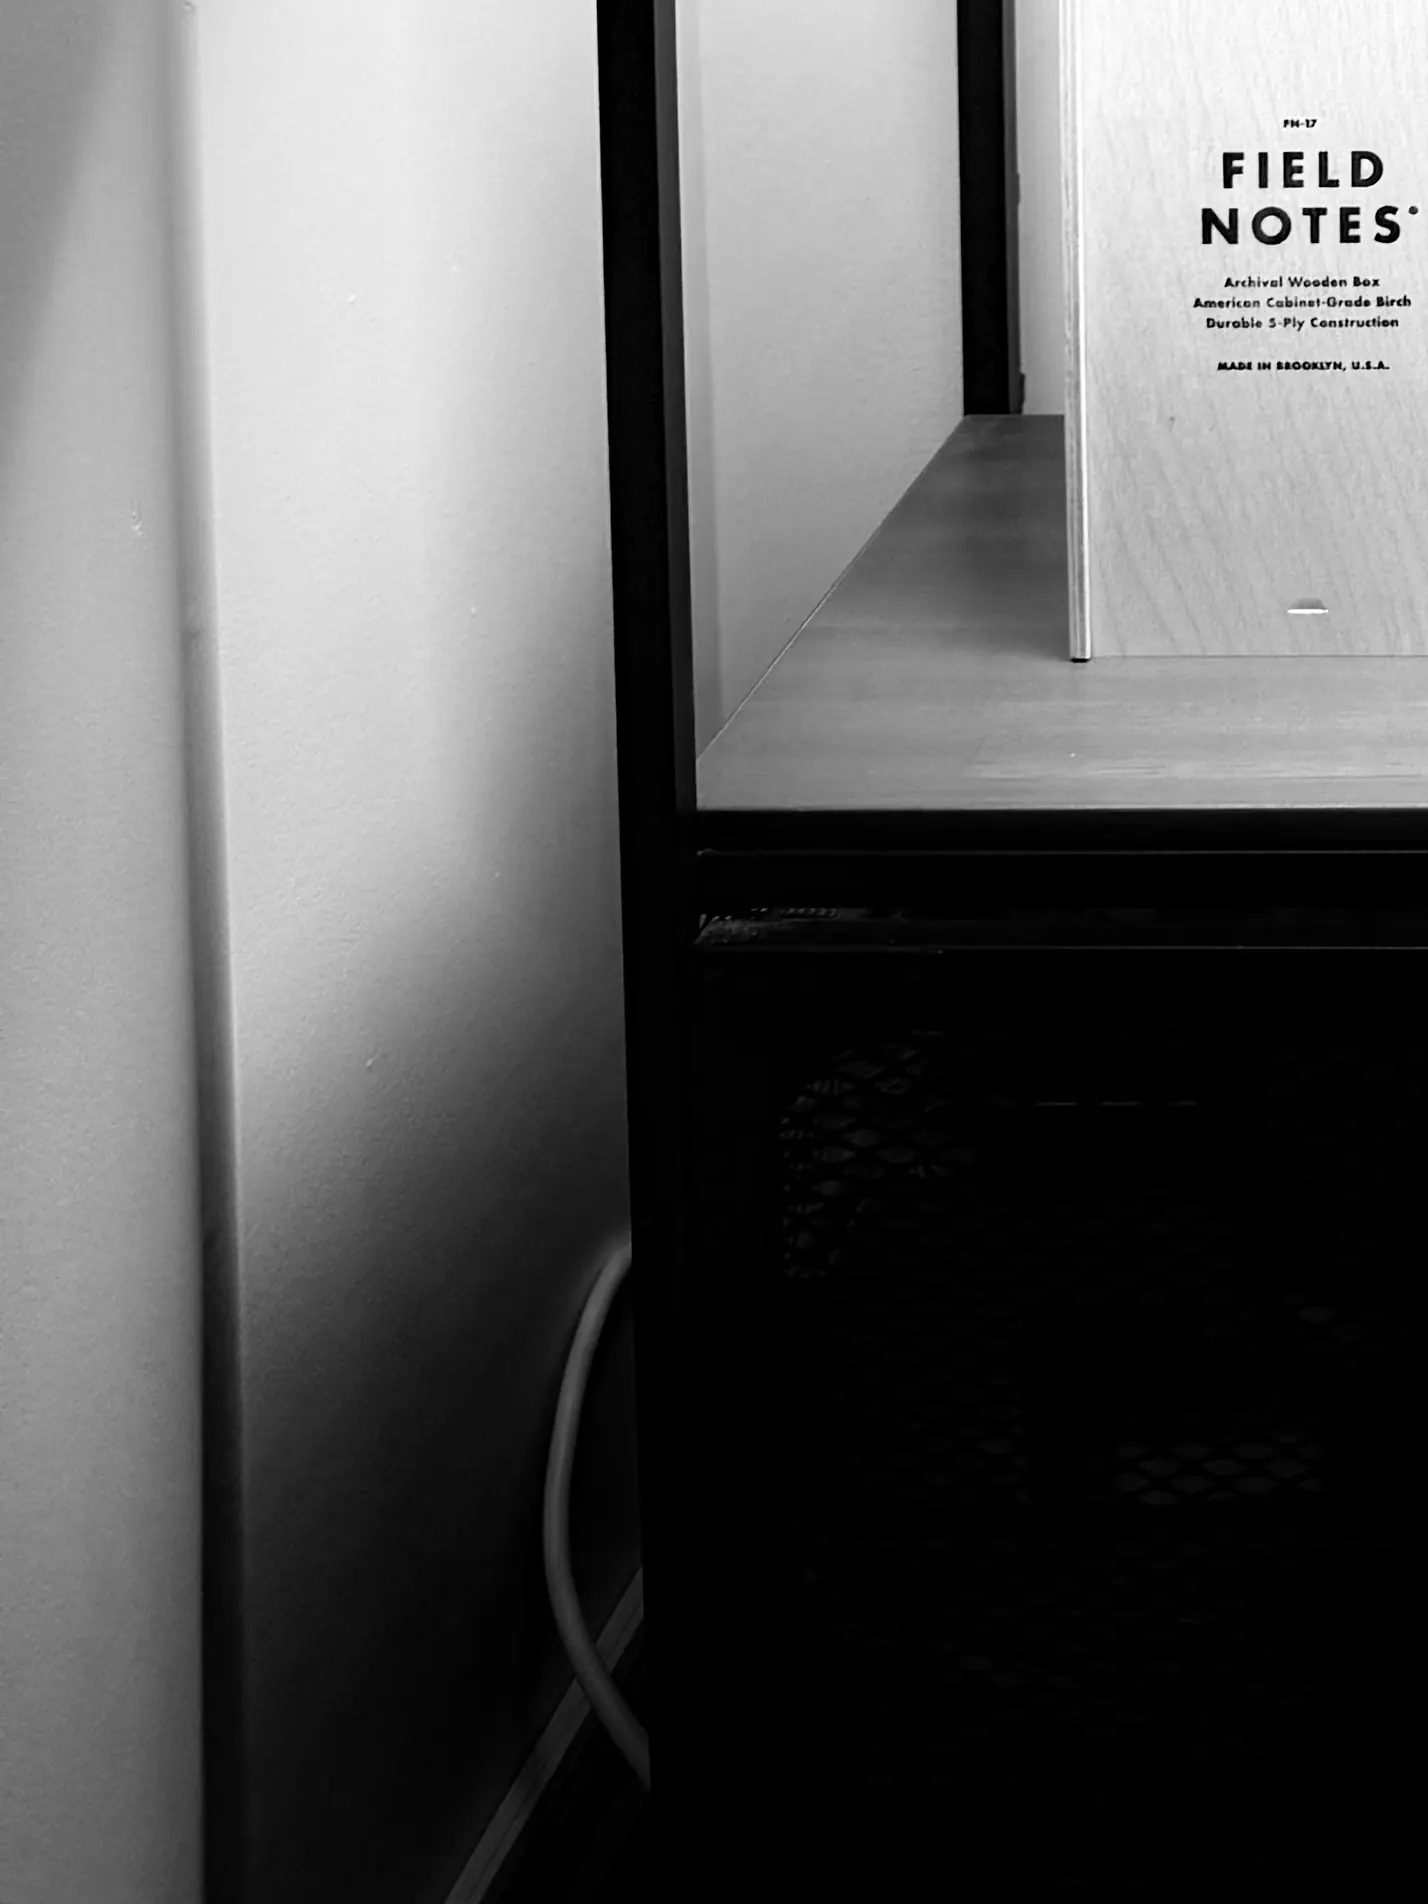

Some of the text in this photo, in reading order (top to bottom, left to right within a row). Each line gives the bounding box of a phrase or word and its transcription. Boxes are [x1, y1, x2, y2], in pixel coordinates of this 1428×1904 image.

[1221, 150, 1385, 189] FIELD
[1223, 275, 1381, 289] Archival Wooden Box
[1193, 294, 1412, 309] American Cabinet-Grade Birch
[1205, 315, 1400, 332] Durable 5-Ply Construction
[1217, 360, 1391, 372] MADE IN BROOKLYN, U.S.A.
